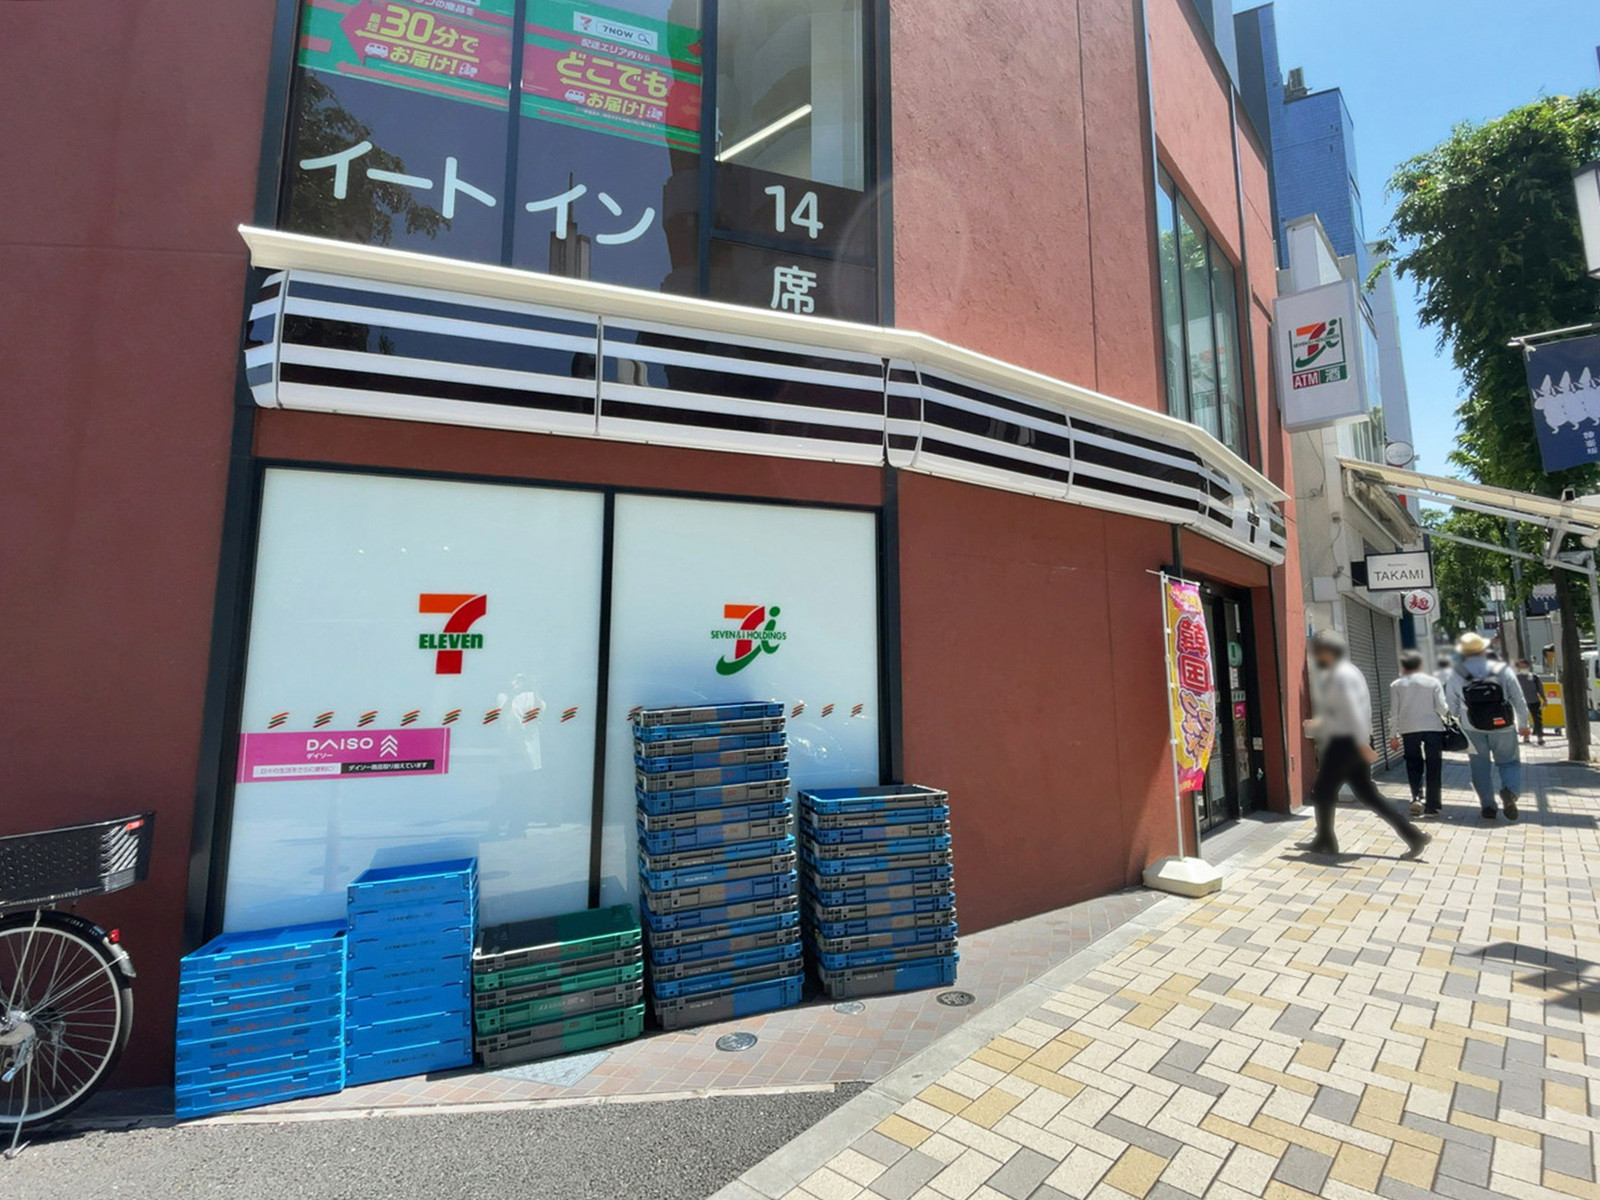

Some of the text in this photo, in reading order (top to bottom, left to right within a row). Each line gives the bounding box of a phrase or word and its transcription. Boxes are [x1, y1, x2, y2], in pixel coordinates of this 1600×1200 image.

[603, 24, 634, 39] 7NOW
[390, 47, 458, 74] お届け!
[556, 51, 668, 98] どこでも
[586, 92, 646, 118] お届け!
[764, 185, 824, 239] 14
[770, 265, 817, 314] 席
[1294, 372, 1320, 388] ATM
[1374, 569, 1424, 581] TAKAMI
[747, 631, 787, 640] HOLDINGS
[306, 737, 374, 751] DAISO
